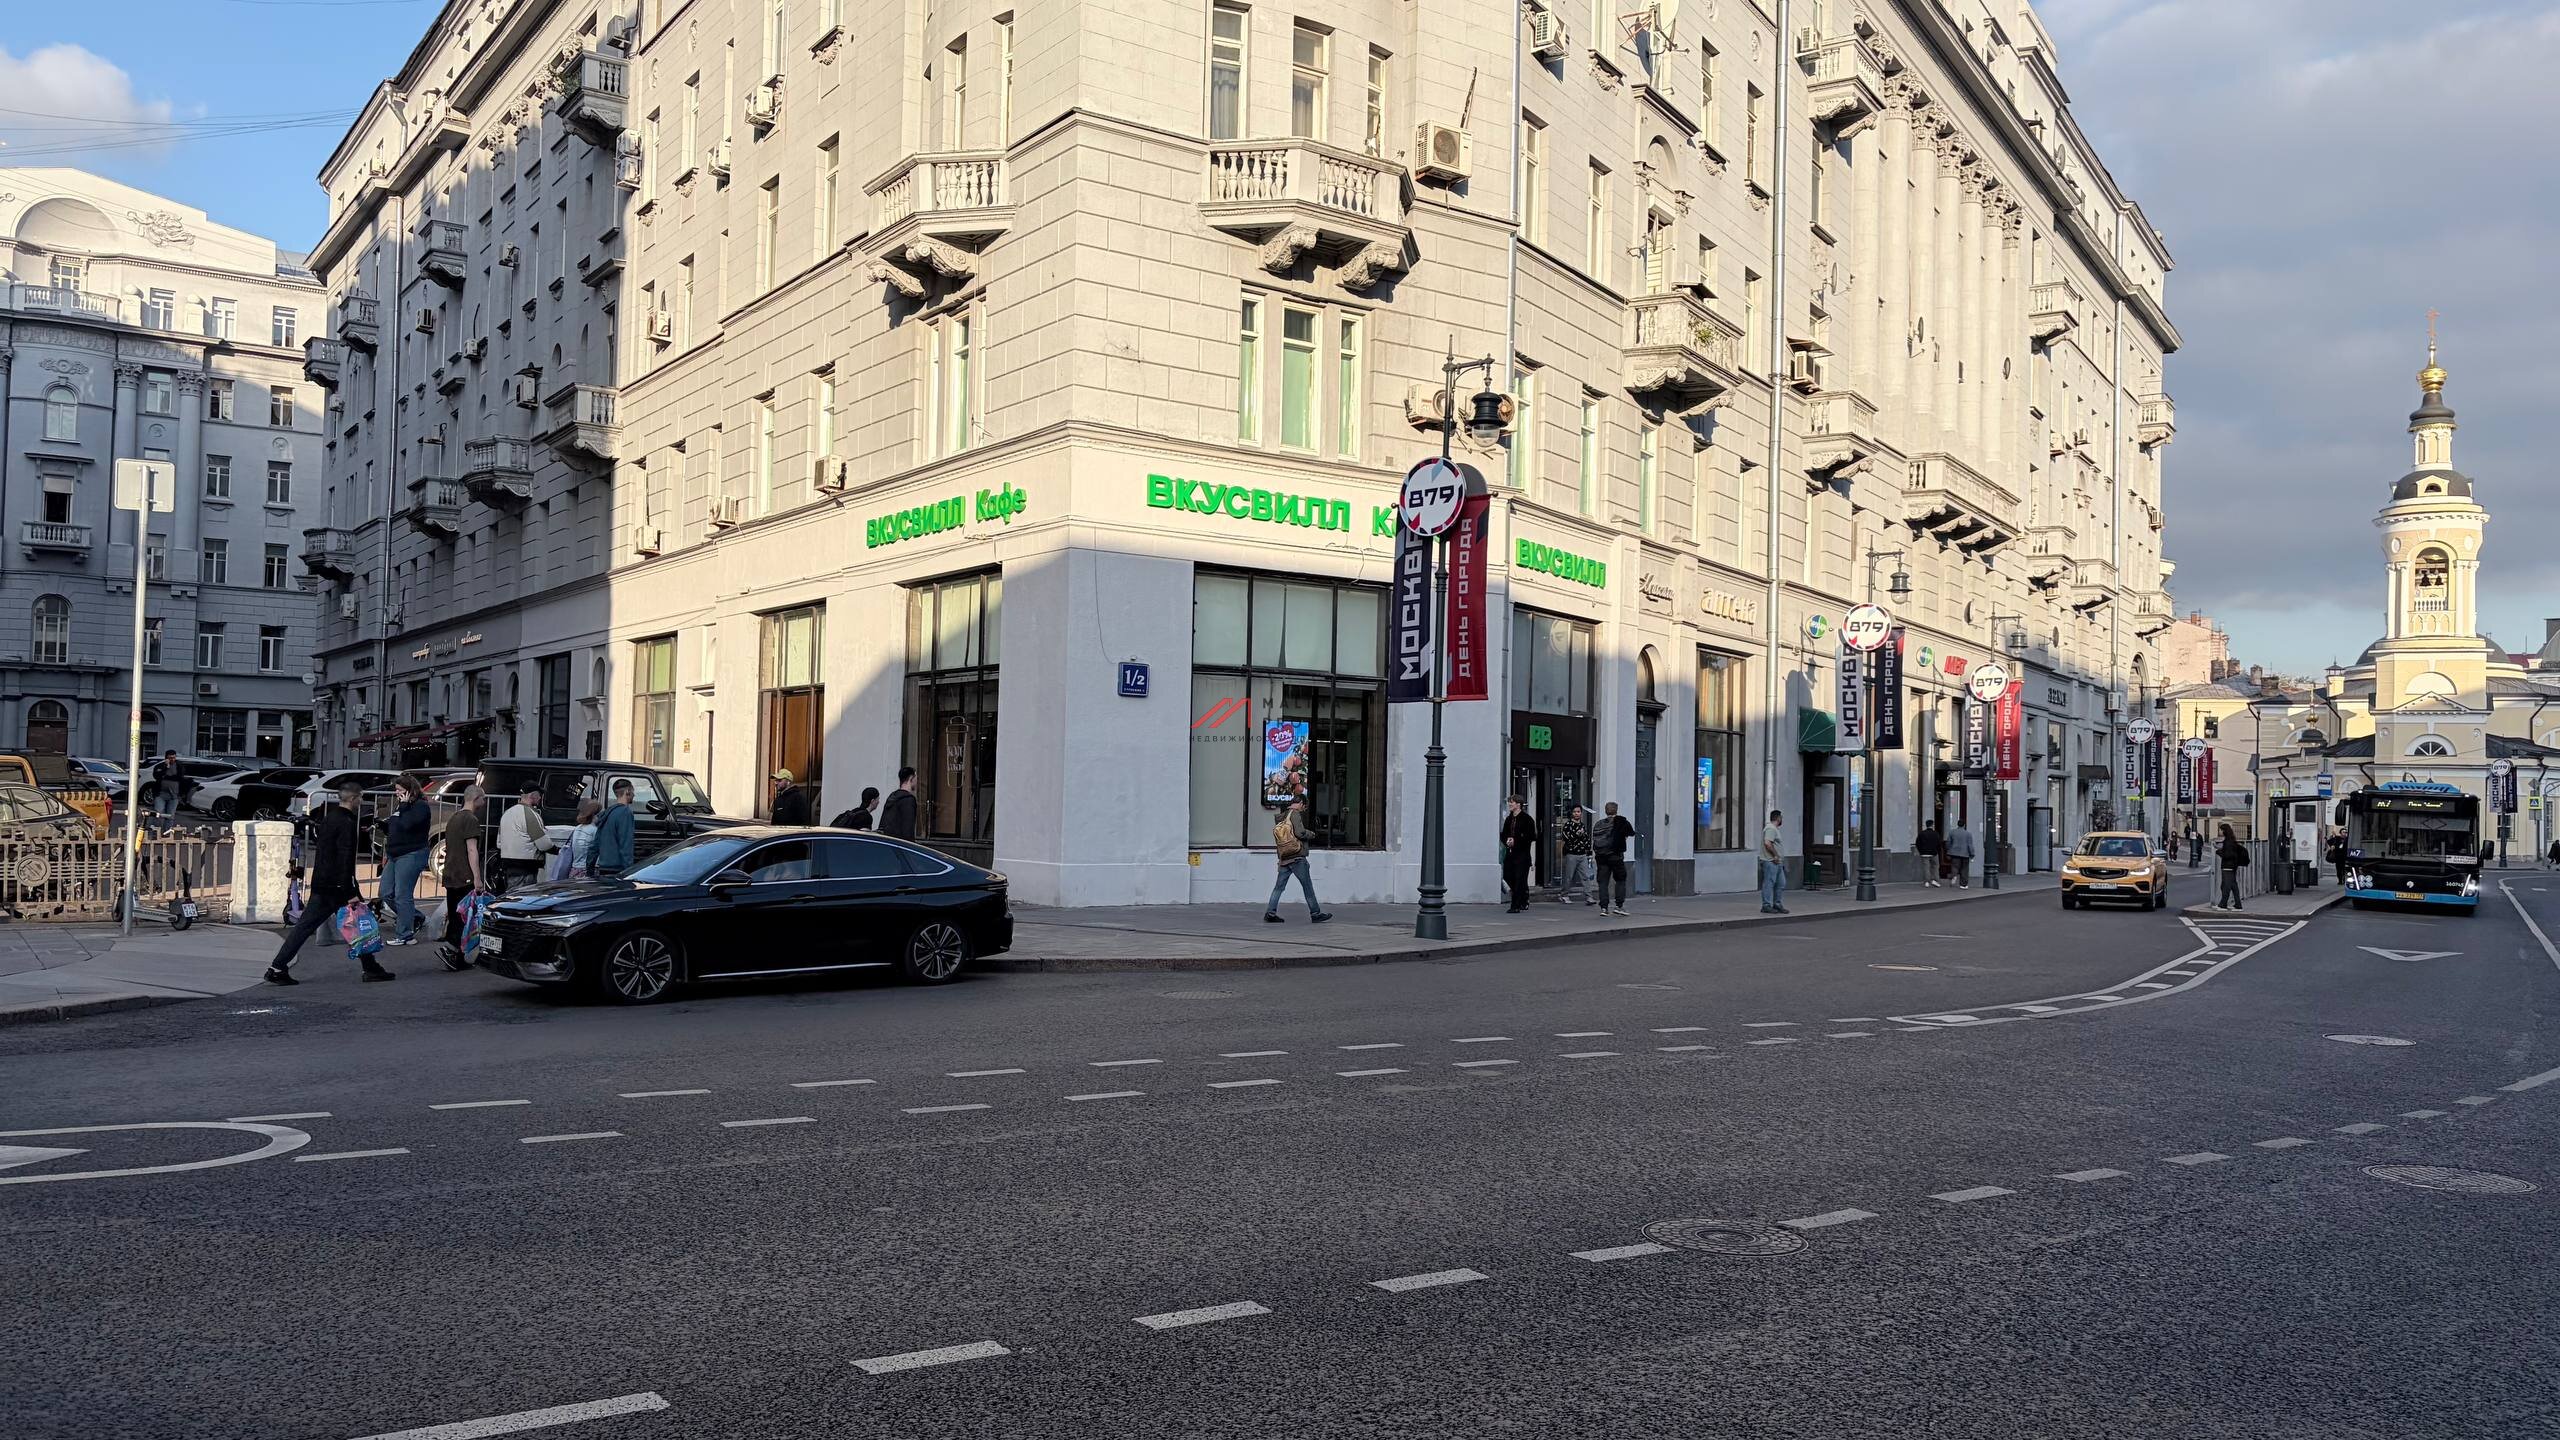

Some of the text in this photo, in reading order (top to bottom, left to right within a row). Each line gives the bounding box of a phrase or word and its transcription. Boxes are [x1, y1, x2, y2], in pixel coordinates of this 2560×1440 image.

[866, 482, 1027, 549] ВКУСВИЛЛ Кафе
[1147, 473, 1350, 532] ВКУСВИЛЛ
[1409, 485, 1455, 509] 879
[1515, 537, 1607, 590] ВКУСВИЛЛ
[1458, 518, 1473, 678] ДЕНЬ ГОРОДА
[1849, 621, 1884, 632] 879
[1125, 669, 1145, 686] 1/2
[1884, 640, 1895, 736] ДЕНЬ ГОРОДА
[1976, 677, 2003, 687] 879
[2003, 692, 2013, 769] ДЕНЬ ГОРОДА
